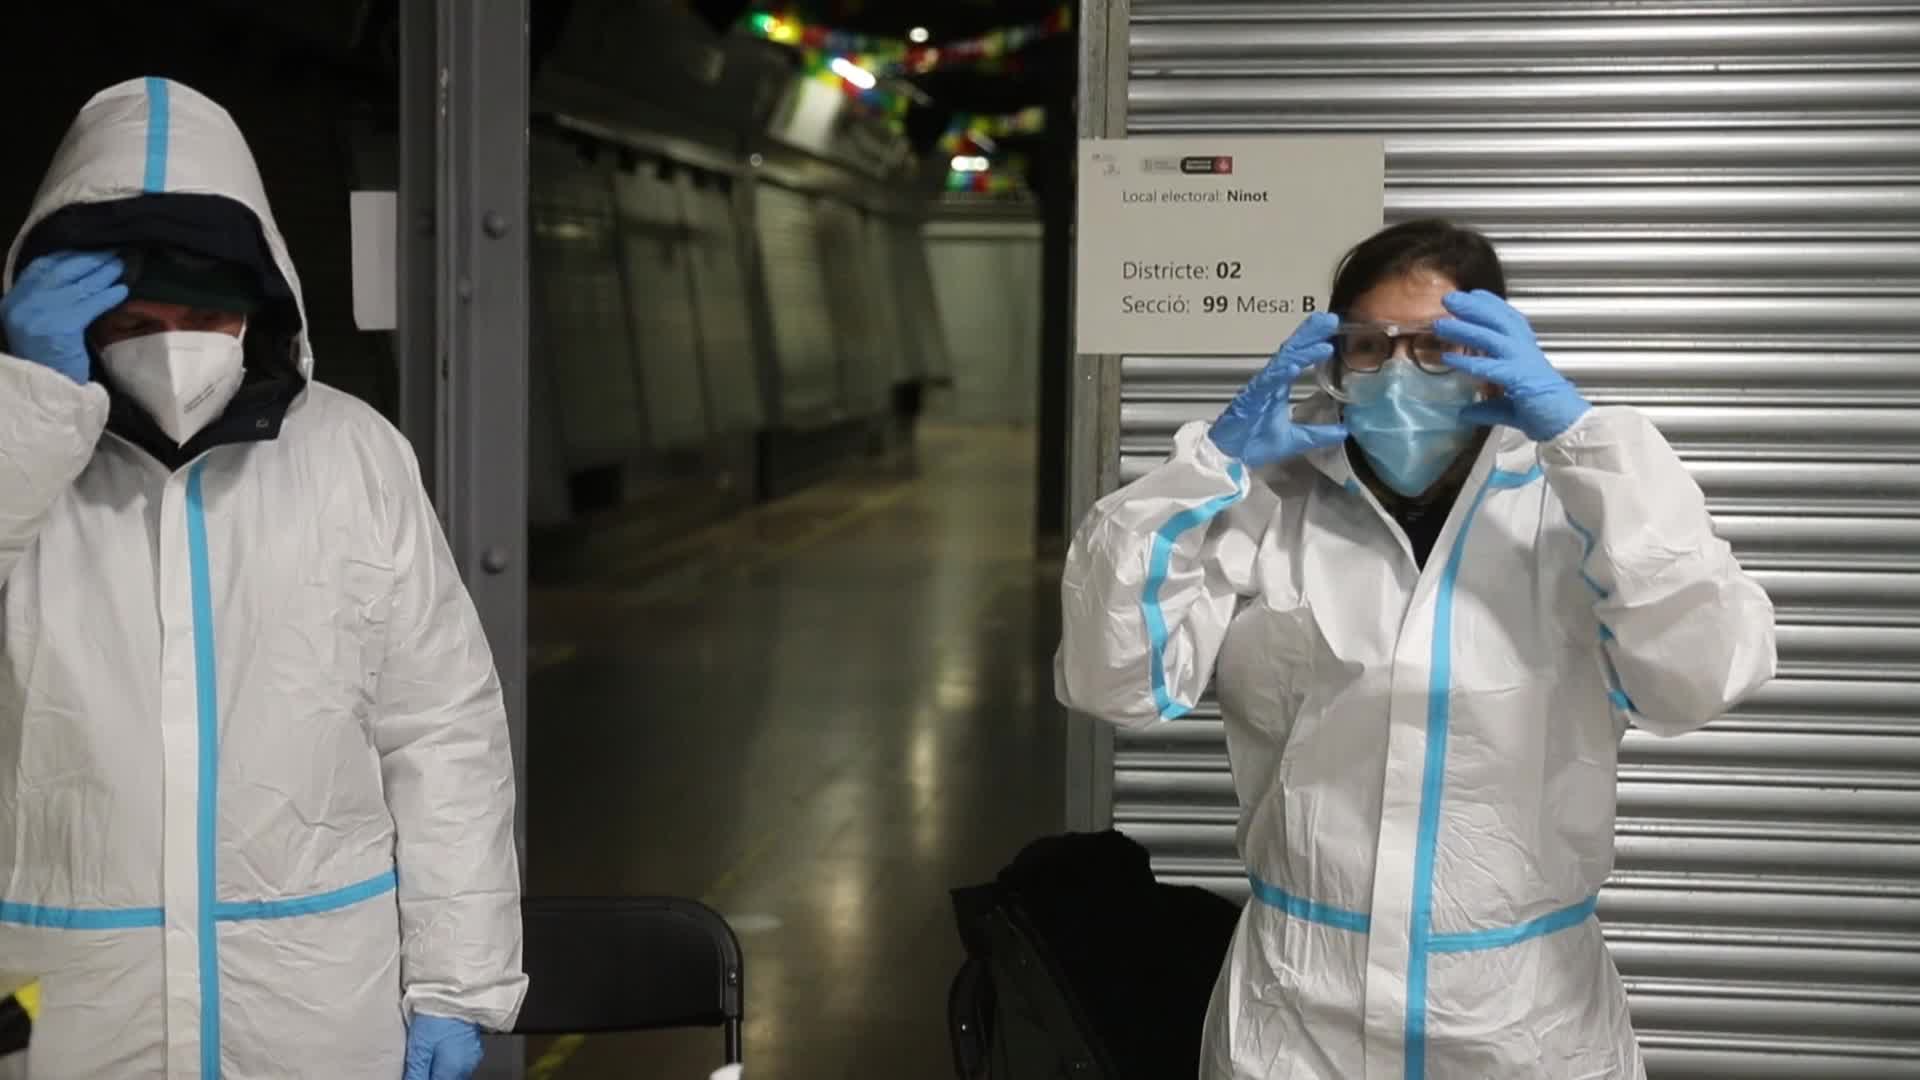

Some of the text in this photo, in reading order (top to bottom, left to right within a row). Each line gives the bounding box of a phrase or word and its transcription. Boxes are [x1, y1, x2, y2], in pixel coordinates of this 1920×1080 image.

[1122, 189, 1268, 203] Local electoral: Ninot
[1122, 261, 1242, 280] Districte: 02
[1122, 295, 1315, 314] Secció: 99 Mesa: B
